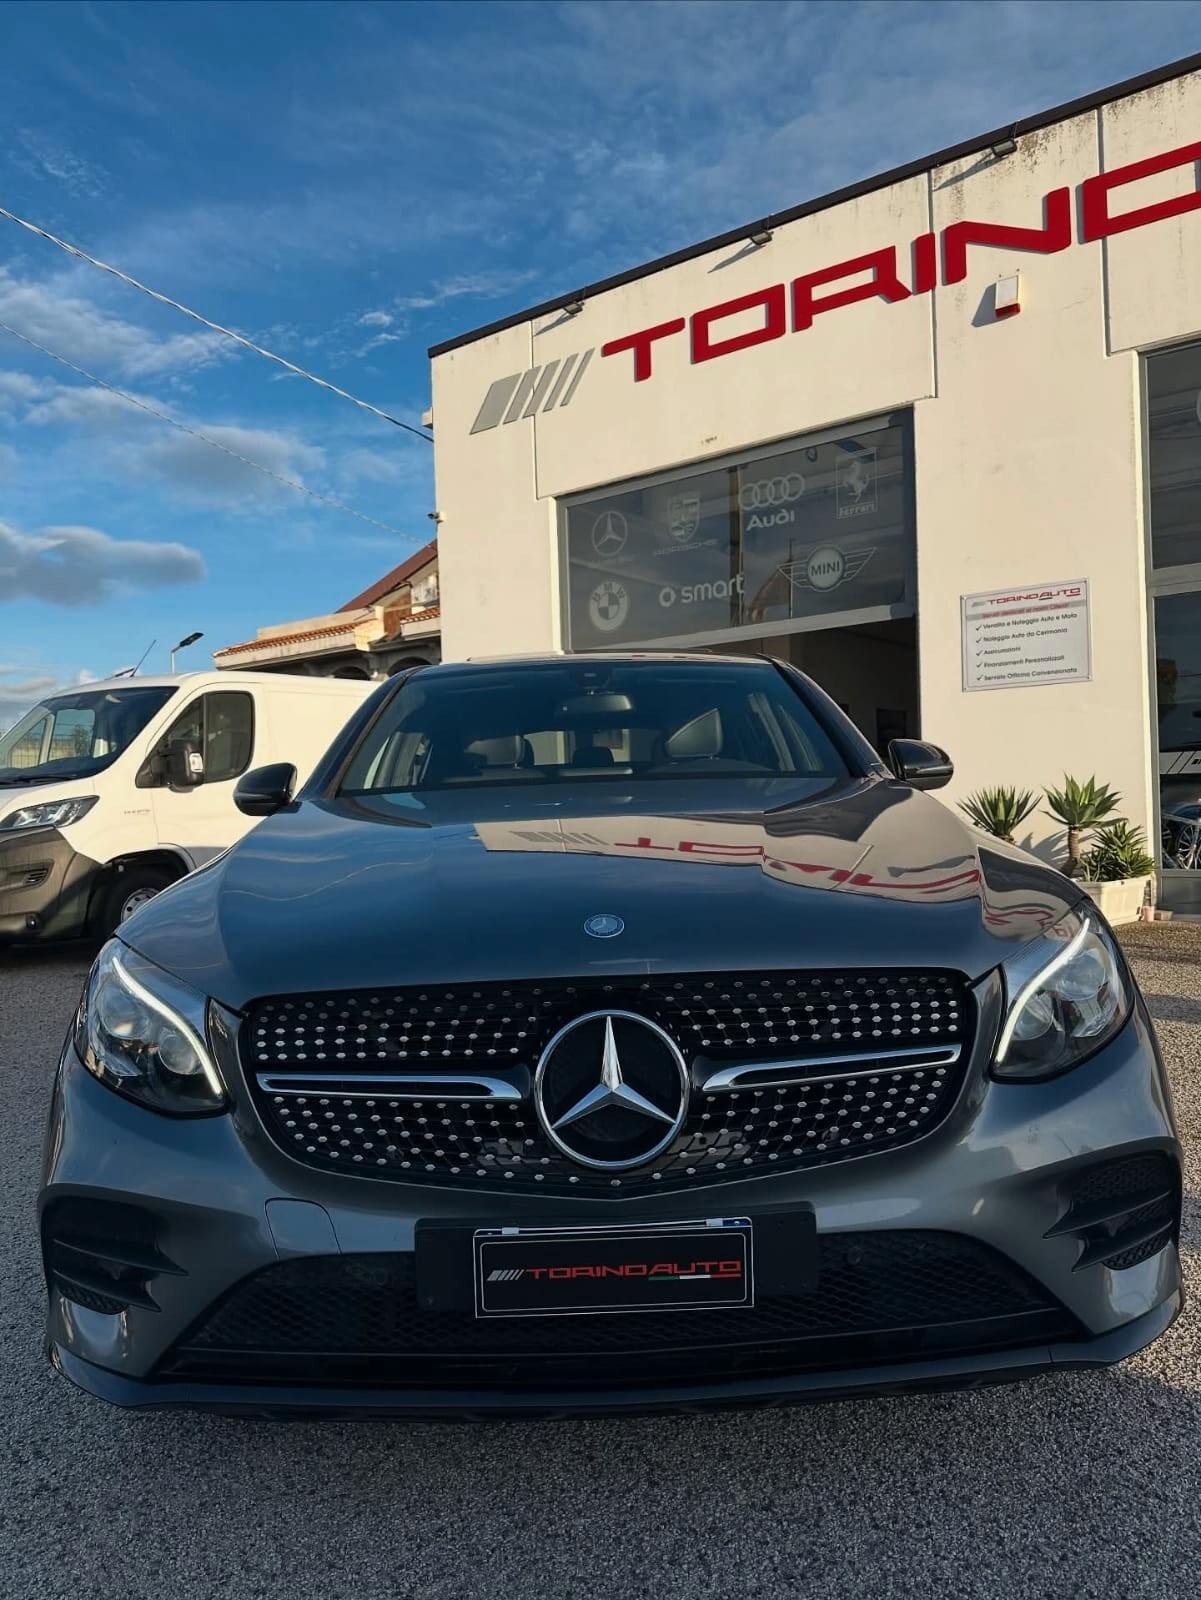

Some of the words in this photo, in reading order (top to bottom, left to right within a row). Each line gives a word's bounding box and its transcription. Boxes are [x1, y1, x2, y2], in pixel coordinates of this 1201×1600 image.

[601, 142, 1201, 382] TORINO
[746, 508, 796, 531] Audi
[810, 561, 841, 577] MINI
[681, 573, 745, 603] smart
[983, 621, 1005, 629] Vendita
[1011, 617, 1038, 627] Noleggio
[983, 633, 1010, 643] Noleggio
